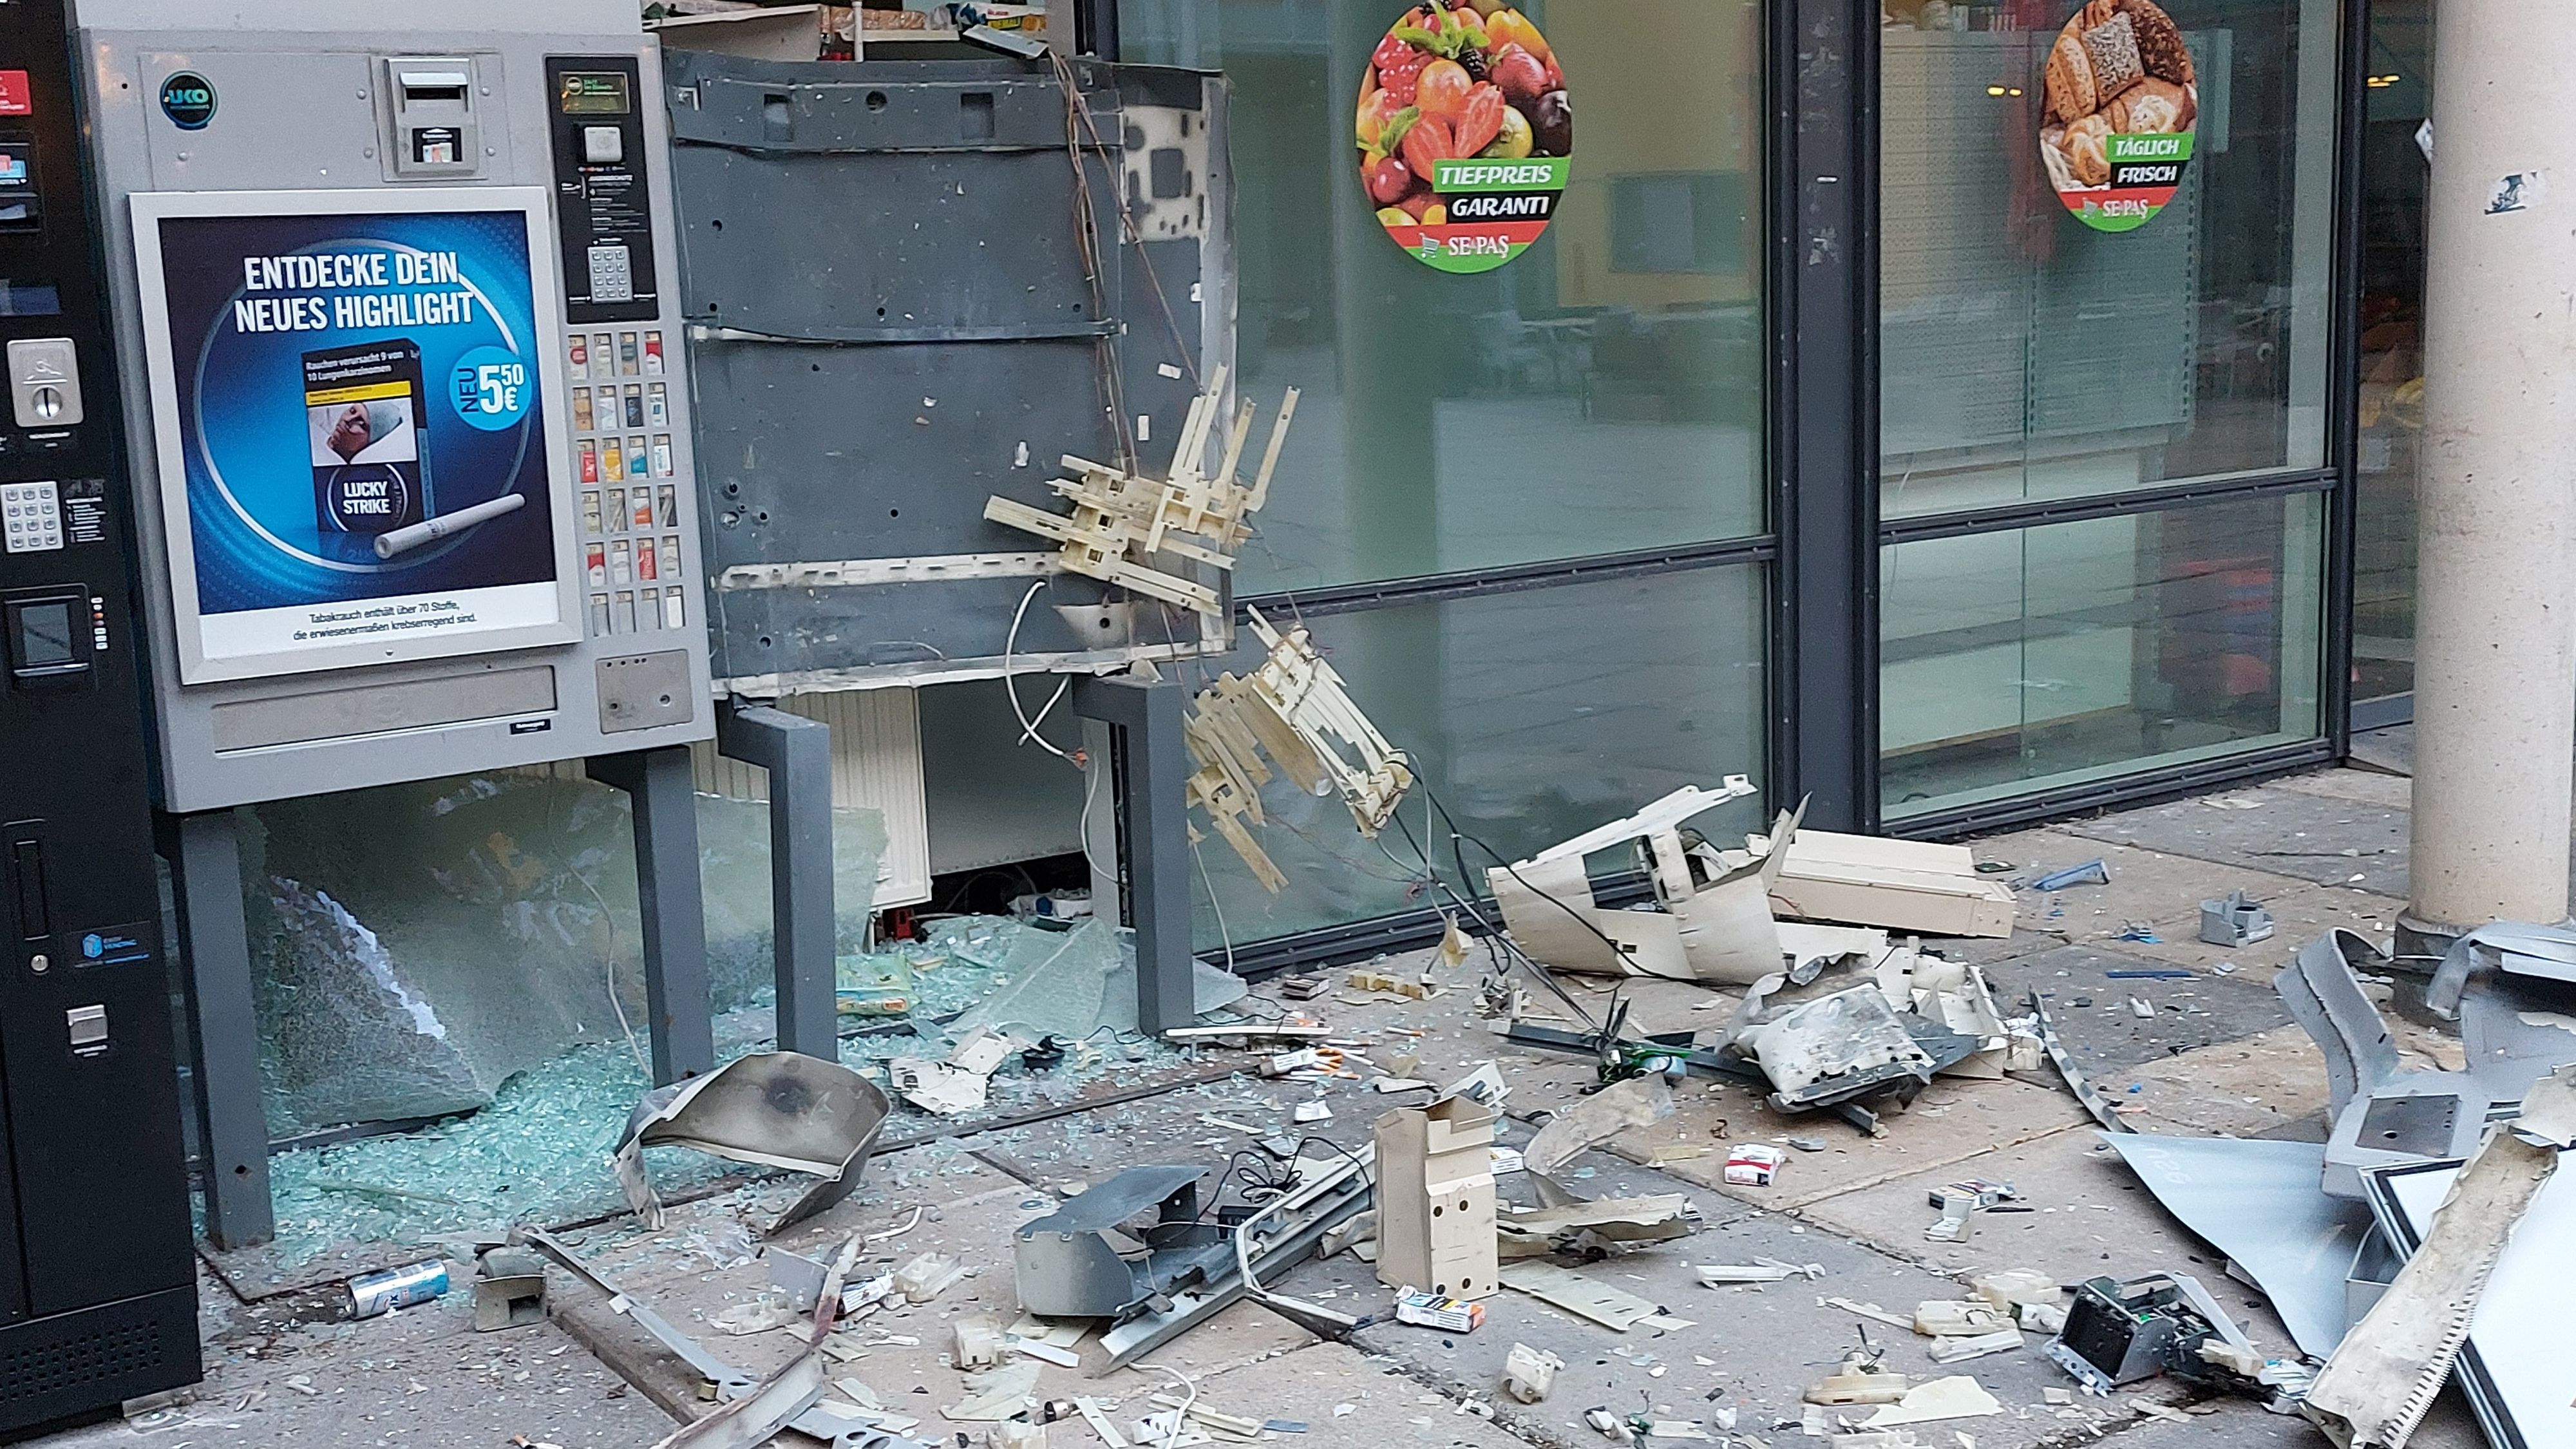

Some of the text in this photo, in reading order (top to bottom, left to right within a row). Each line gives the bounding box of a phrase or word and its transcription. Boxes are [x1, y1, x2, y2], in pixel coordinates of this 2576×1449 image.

[2116, 137, 2179, 156] TÄGLICH
[1439, 165, 1552, 185] TIEFPREIS
[2117, 166, 2177, 184] FRISCH
[1452, 196, 1549, 216] GARANTI
[243, 252, 460, 290] ENTDECKE DEIN
[234, 292, 473, 332] NEUES HIGHLIGHT
[457, 368, 479, 412] NEU
[343, 480, 388, 497] LUCKY
[343, 498, 392, 515] STRIKE
[309, 600, 460, 623] Tabakrauch enthält über 70 Stoffe,
[293, 630, 307, 640] die
[309, 623, 389, 639] erwiesenermaßen
[392, 616, 454, 630] krebserregend
